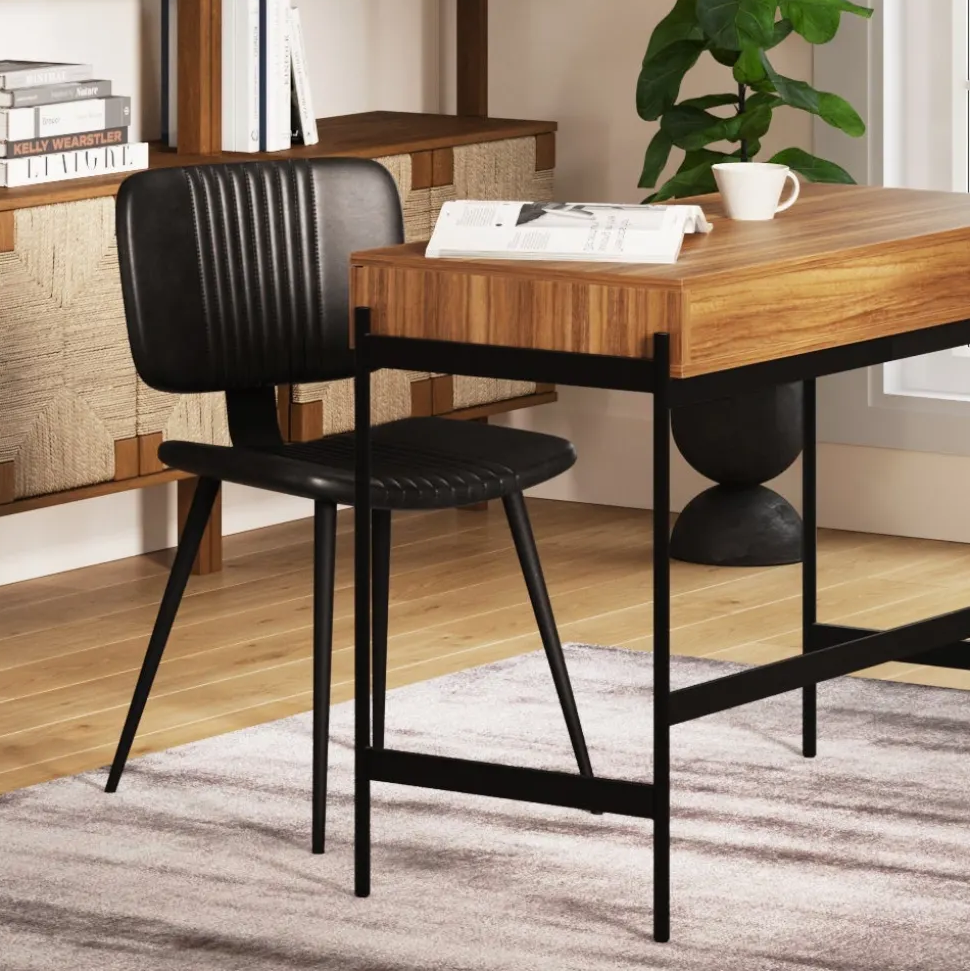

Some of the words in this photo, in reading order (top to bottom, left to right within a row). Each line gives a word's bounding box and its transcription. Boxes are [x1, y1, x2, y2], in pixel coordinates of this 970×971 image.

[76, 86, 98, 97] Nature
[13, 140, 49, 156] KELLY
[52, 130, 122, 150] WEARSTLER
